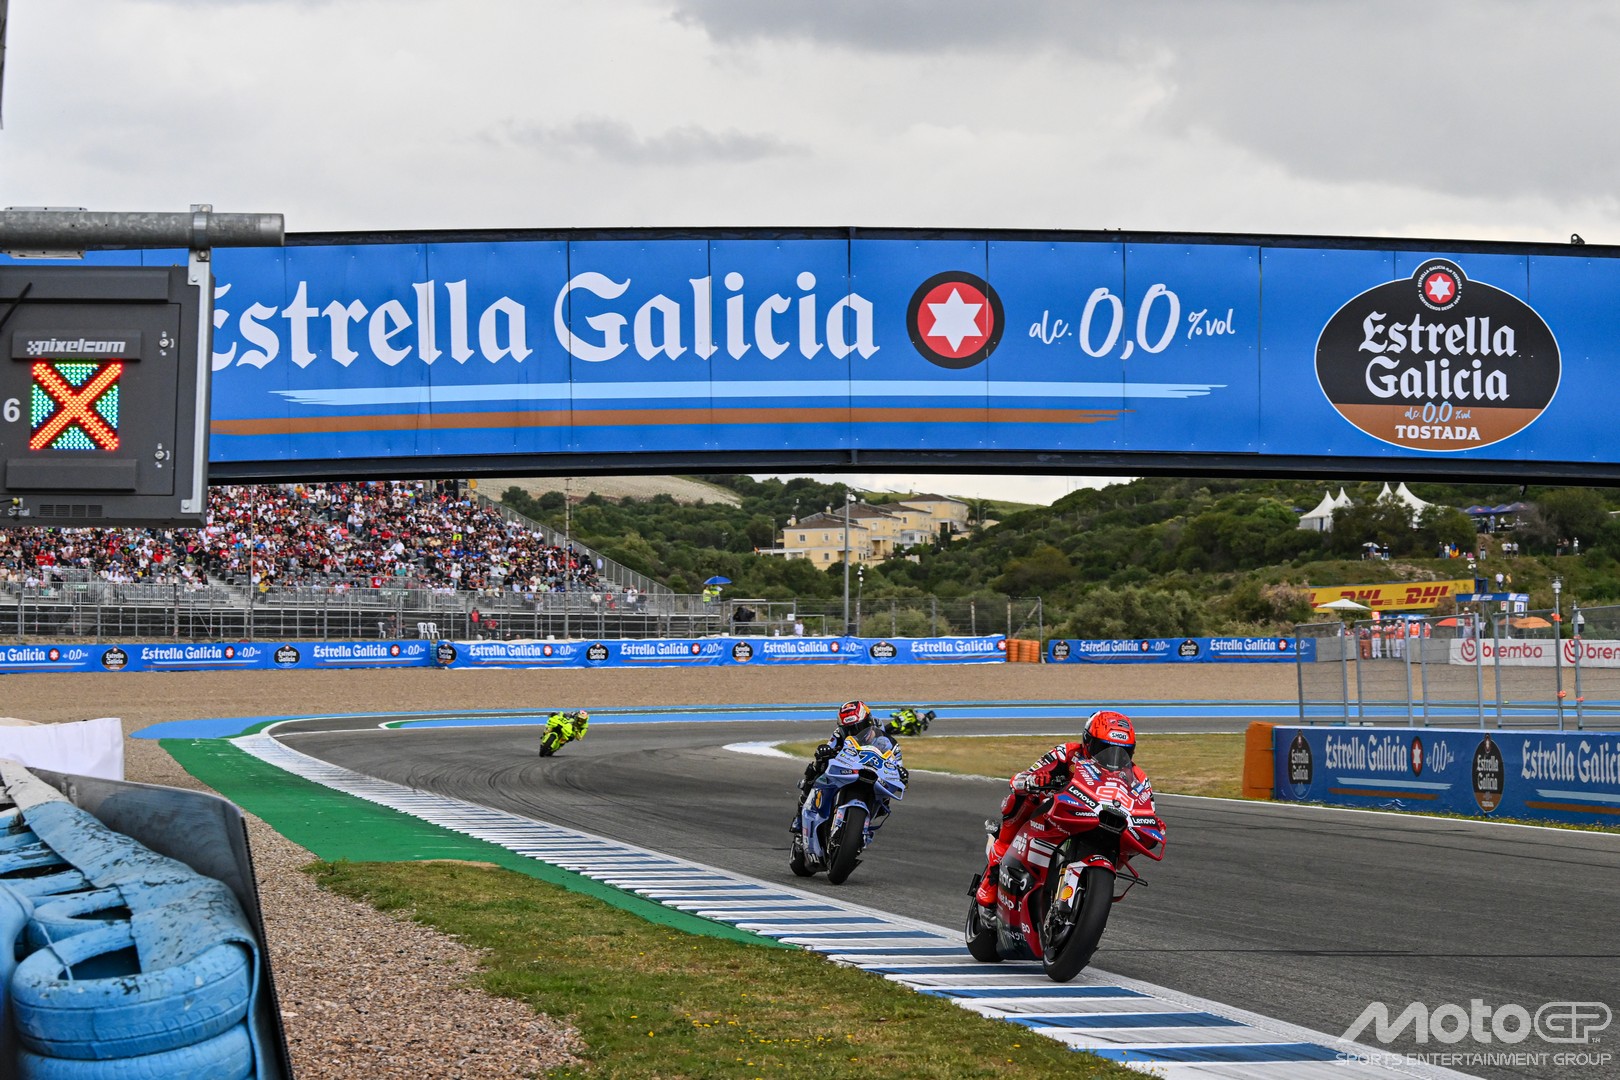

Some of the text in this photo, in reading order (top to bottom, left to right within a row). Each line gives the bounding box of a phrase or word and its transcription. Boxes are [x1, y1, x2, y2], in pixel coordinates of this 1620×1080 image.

[553, 271, 879, 362] Galicia
[1029, 310, 1072, 344] alc.
[1079, 283, 1180, 359] 0,0
[1359, 311, 1516, 356] Estrella
[36, 338, 126, 354] pixelcom
[1366, 356, 1510, 401] Galicia
[4, 398, 20, 422] 6
[1423, 401, 1453, 424] 0,0
[1395, 425, 1481, 440] TOSTADA
[141, 648, 183, 660] Estrella
[185, 646, 221, 659] Galicia
[313, 646, 350, 657] Estrella
[353, 644, 387, 657] Galicia
[469, 644, 506, 656] Estrella
[507, 645, 540, 656] Galicia
[620, 643, 655, 655] Estrella
[657, 643, 688, 655] Galicia
[764, 642, 796, 653] Estrella
[797, 641, 828, 653] Galicia
[911, 640, 993, 653] Estrella Galicia
[1080, 641, 1110, 652] Estrella
[1112, 640, 1138, 652] Galicia
[1210, 639, 1275, 651] Estrella Galicia
[1482, 642, 1542, 658] bembo
[8, 648, 45, 661] Galicia
[1326, 734, 1366, 769] Estrella
[1368, 734, 1407, 772] Galicia
[1521, 739, 1575, 782] Estrella
[1477, 755, 1498, 771] Estrella
[1478, 772, 1498, 790] Galicia
[1068, 786, 1096, 807] Lenovo
[1096, 786, 1134, 811] 93
